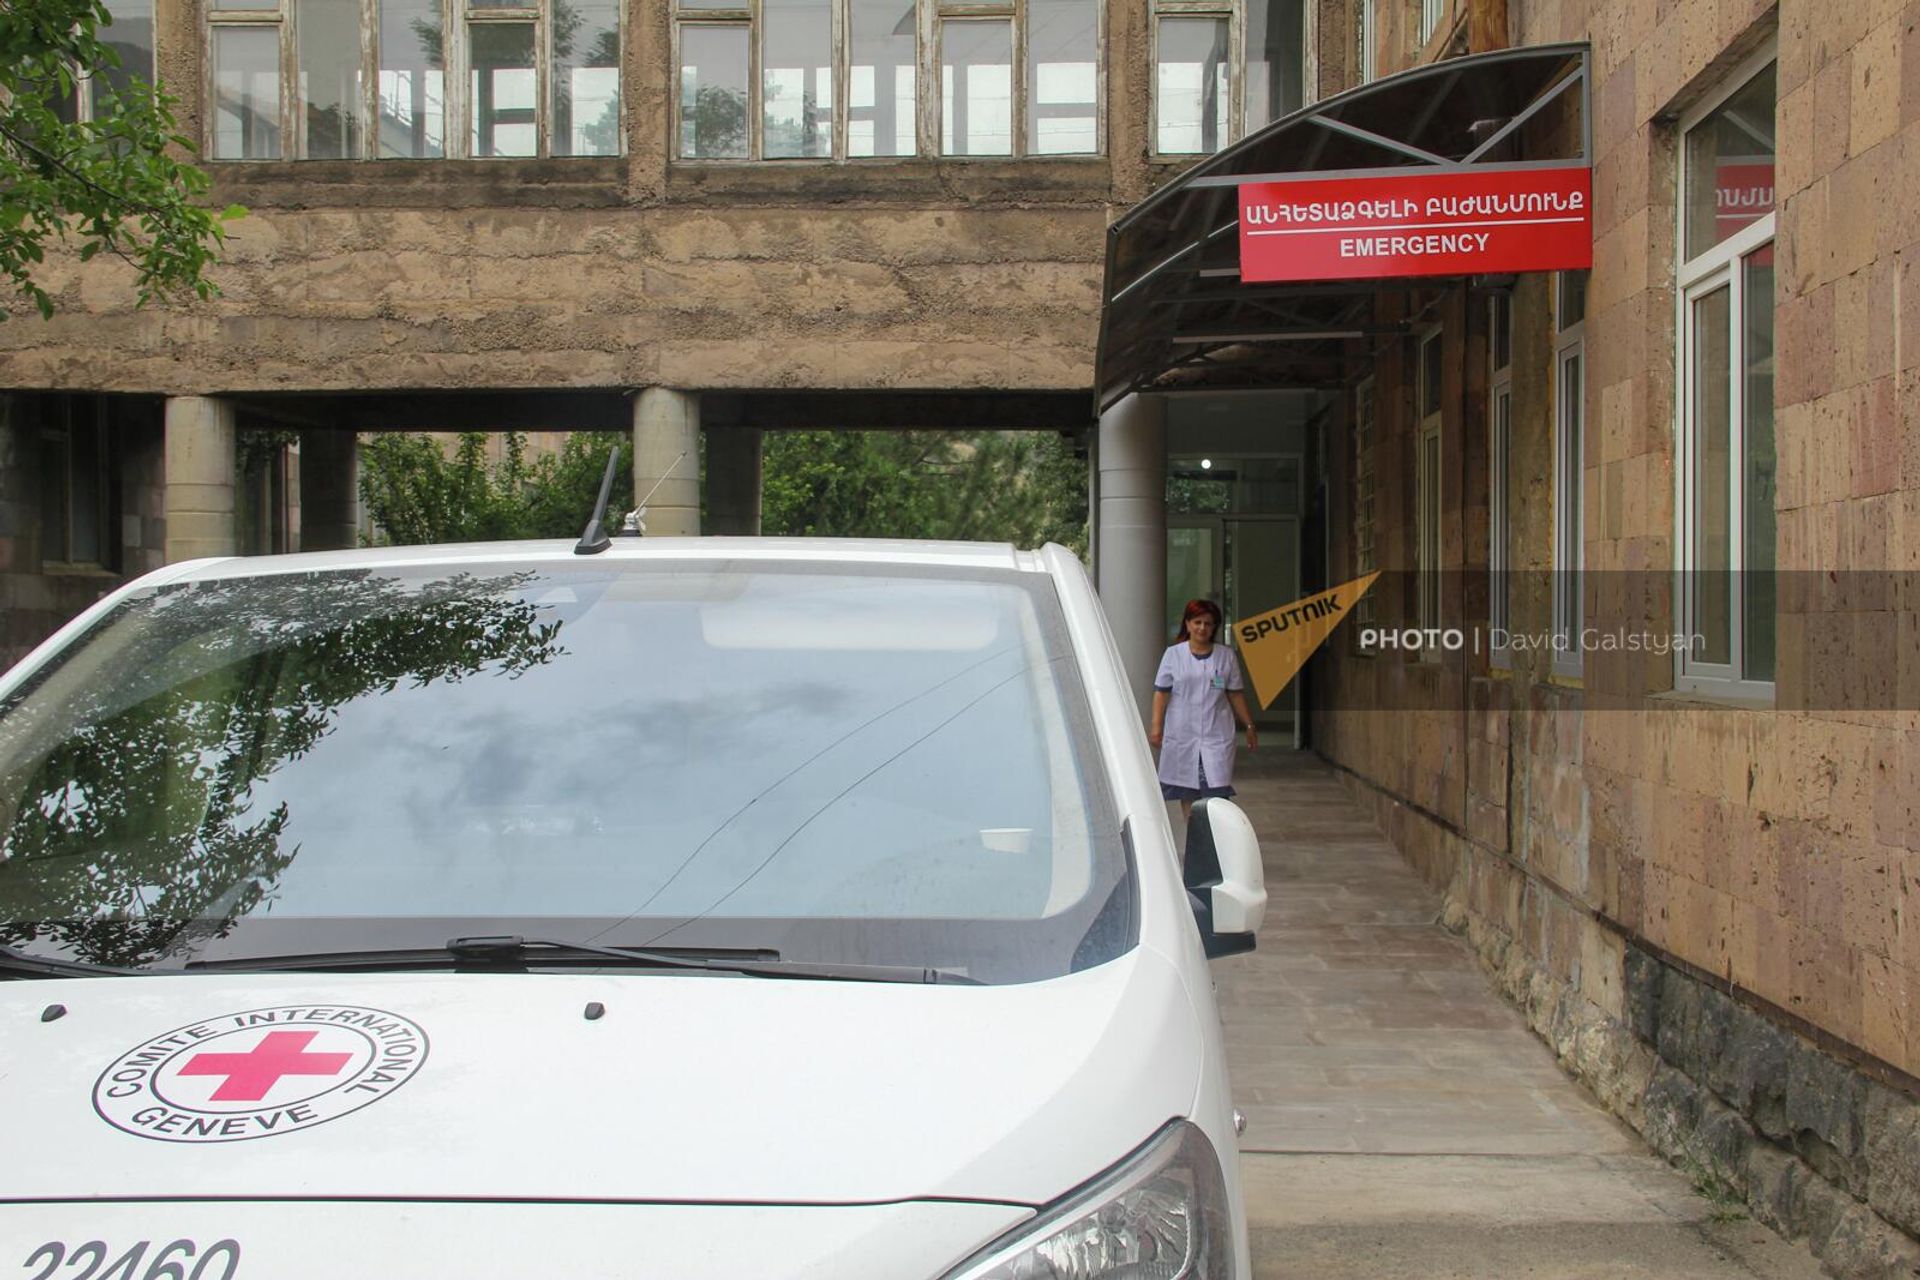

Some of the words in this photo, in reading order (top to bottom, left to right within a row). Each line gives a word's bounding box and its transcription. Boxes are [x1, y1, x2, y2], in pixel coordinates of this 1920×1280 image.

[1246, 199, 1418, 225] ԱՆՀԵՏԱՁԳԵԼԻ
[1426, 191, 1584, 217] ԲԱԺԱՆՄՈՒՆՔ
[1340, 233, 1490, 257] EMERGENCY
[106, 1025, 218, 1099] COMITE
[234, 1008, 418, 1094] INTERNATIONAL
[132, 1104, 318, 1136] GENEVE
[22, 1238, 241, 1280] 22460
